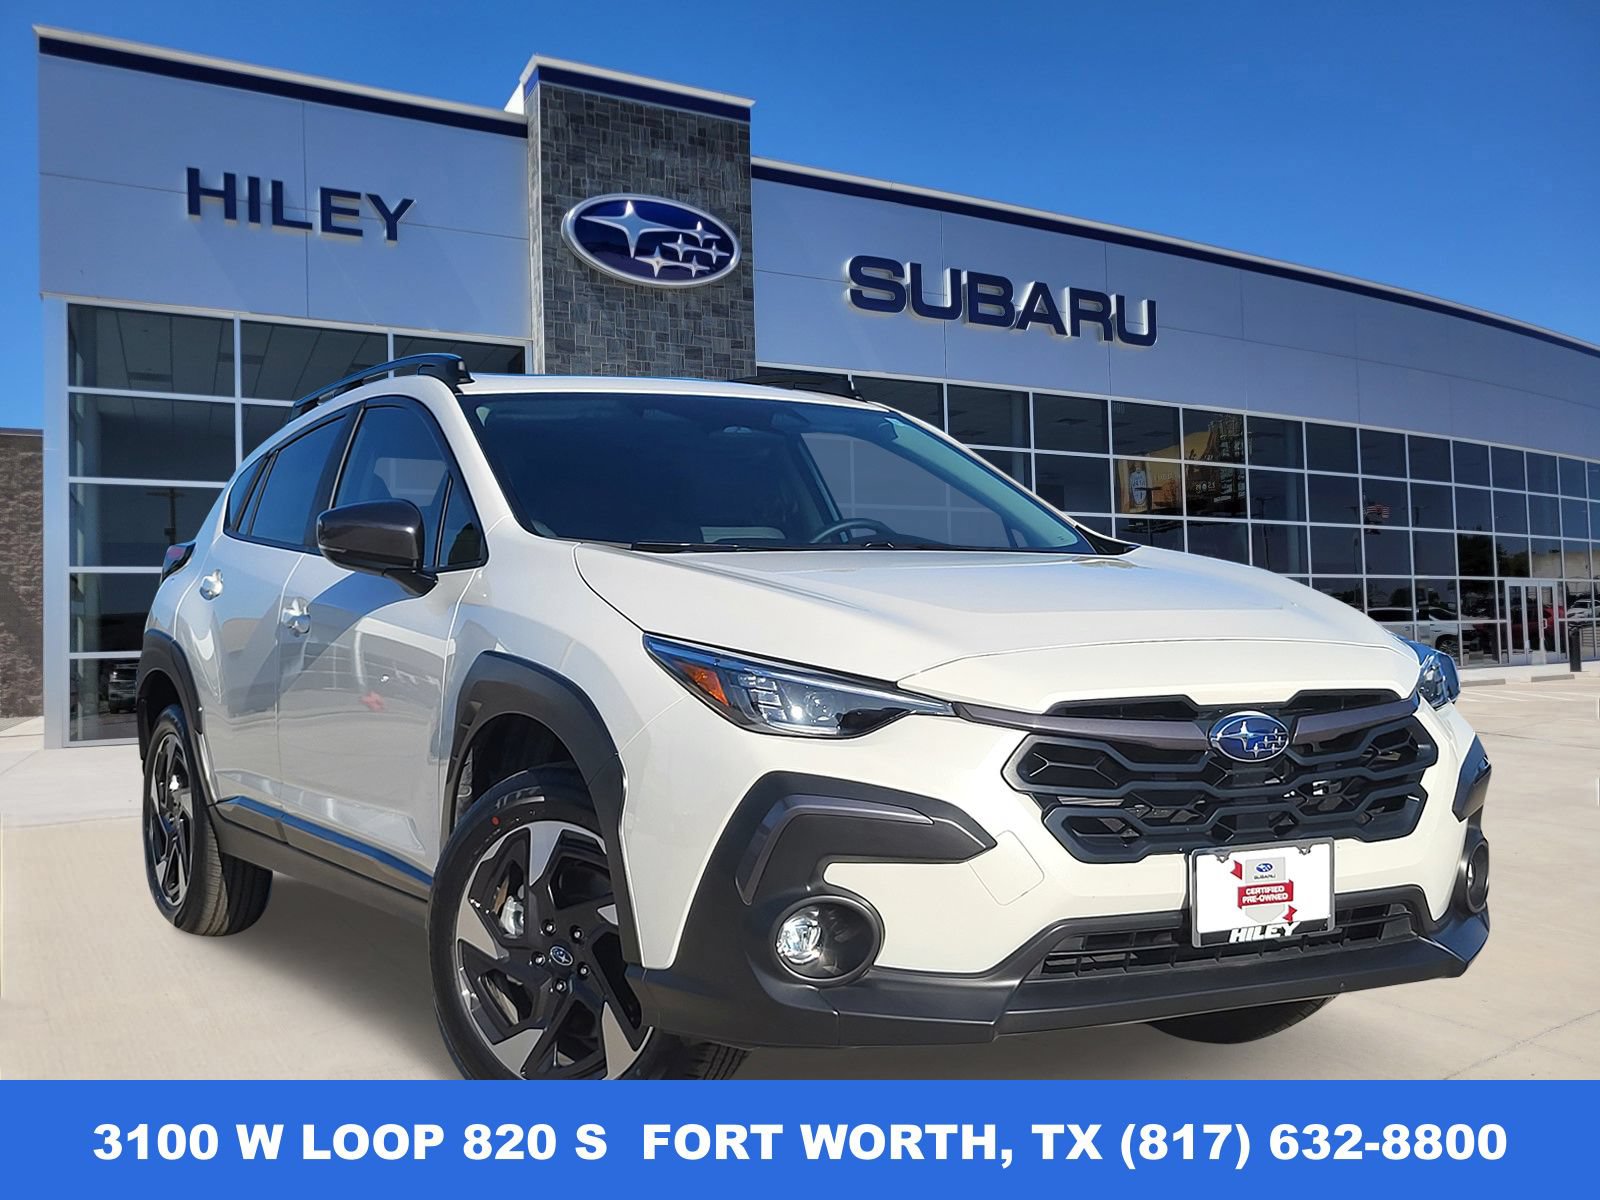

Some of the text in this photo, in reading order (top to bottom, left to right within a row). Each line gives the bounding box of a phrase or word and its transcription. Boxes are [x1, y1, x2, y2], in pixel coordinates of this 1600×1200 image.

[186, 166, 416, 242] HILEY
[847, 254, 1158, 348] SUBARU
[1243, 893, 1288, 904] PRE-OWNED
[1246, 886, 1284, 895] CERTIFIED
[1229, 922, 1300, 943] HILEY
